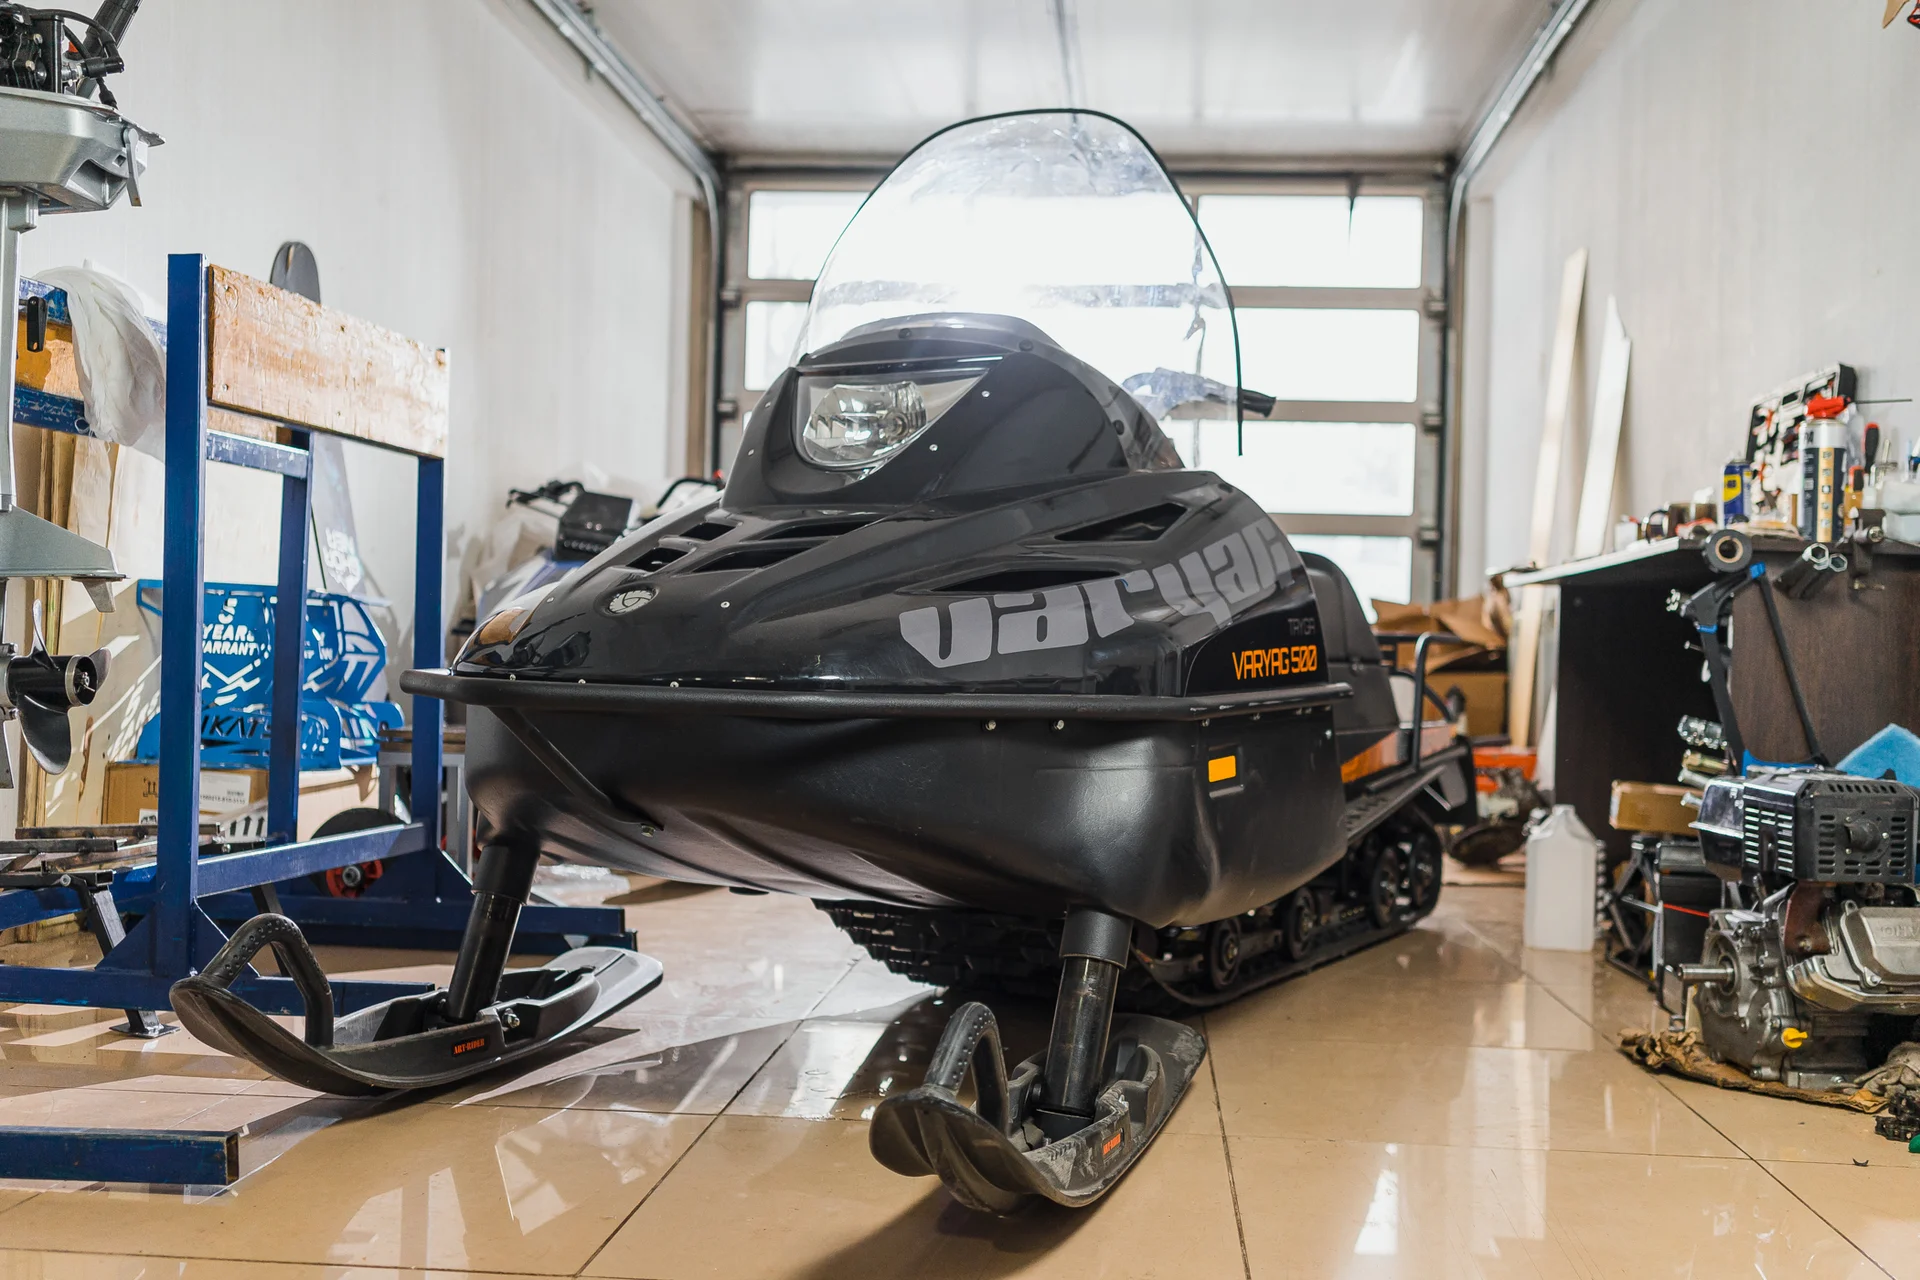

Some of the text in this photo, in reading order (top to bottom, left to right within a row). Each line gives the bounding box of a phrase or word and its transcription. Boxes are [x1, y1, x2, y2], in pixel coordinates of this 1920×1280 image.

[202, 640, 260, 656] ARRANT
[1232, 644, 1317, 680] VARYAG 500
